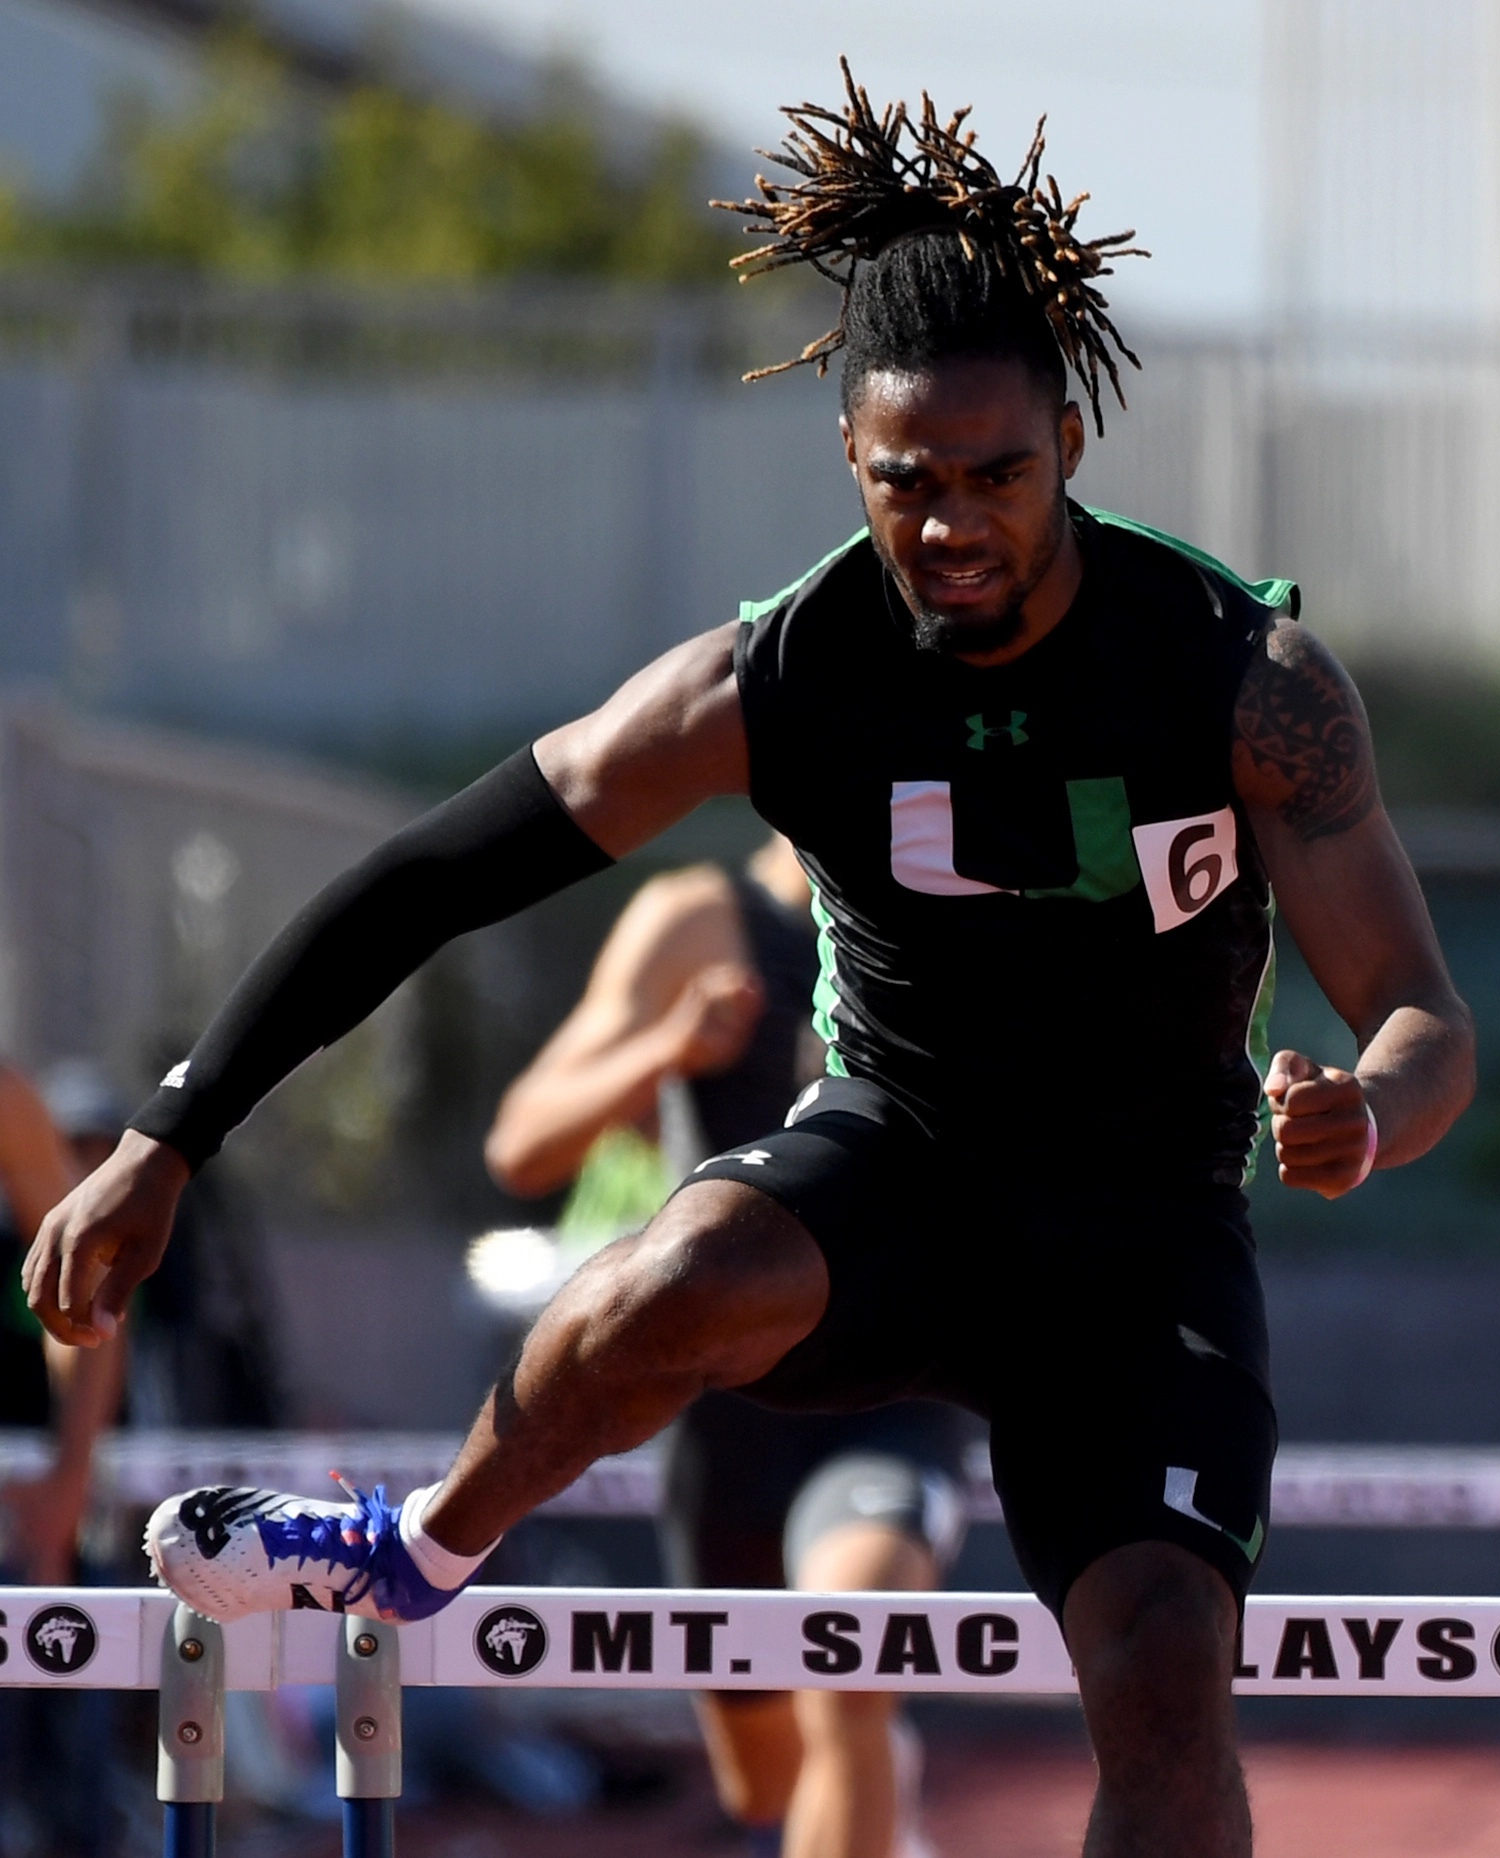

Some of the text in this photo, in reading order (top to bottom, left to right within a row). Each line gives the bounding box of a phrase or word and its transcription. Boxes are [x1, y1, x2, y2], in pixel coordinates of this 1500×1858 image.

[890, 776, 1141, 902] U
[1167, 823, 1222, 914] 6
[570, 1610, 752, 1675] MT.
[800, 1610, 1020, 1677] SAC
